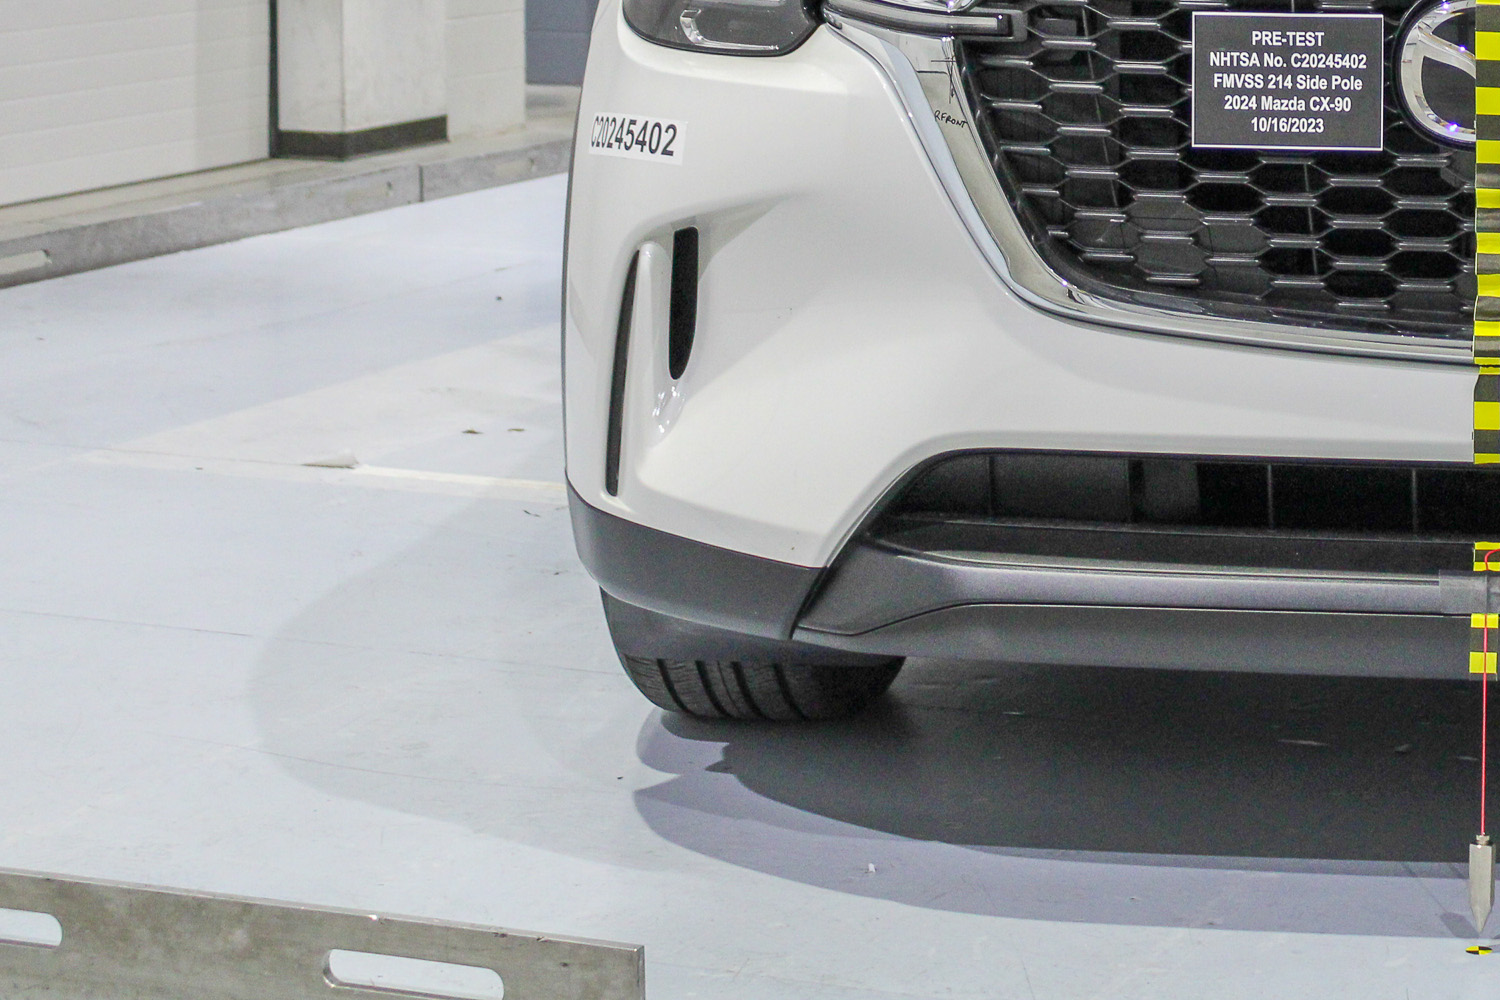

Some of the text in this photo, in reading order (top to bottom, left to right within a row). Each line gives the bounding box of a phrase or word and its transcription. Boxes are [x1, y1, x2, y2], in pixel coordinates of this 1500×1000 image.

[1253, 31, 1324, 46] PRE-TEST
[1210, 52, 1366, 68] NHTSA No. C20245402
[1214, 74, 1362, 90] FMVSS 214 Side Pole
[1224, 95, 1351, 111] 2024 Mazda CX-90
[1252, 117, 1324, 132] 10/16/2023
[591, 115, 678, 157] C20245402
